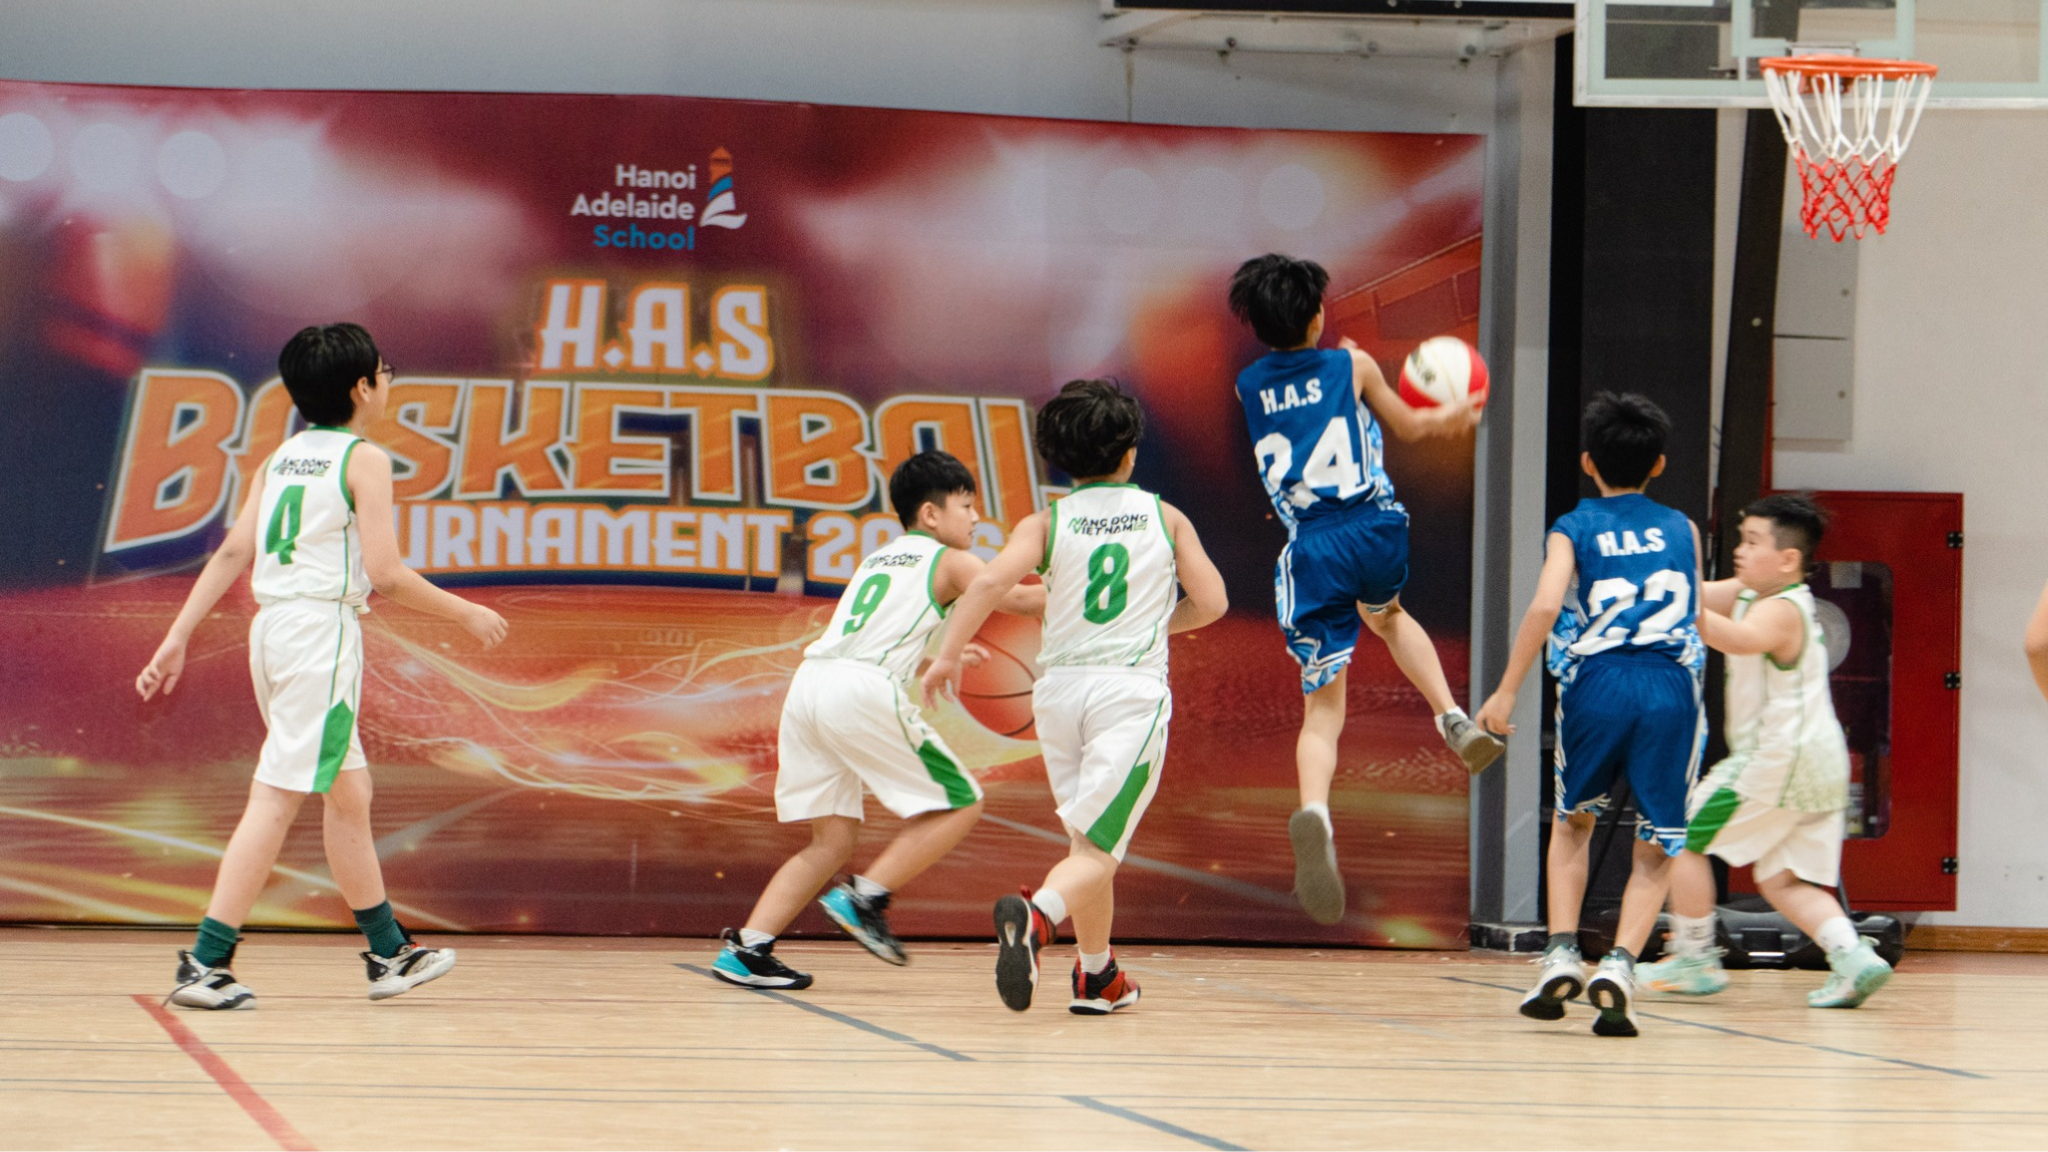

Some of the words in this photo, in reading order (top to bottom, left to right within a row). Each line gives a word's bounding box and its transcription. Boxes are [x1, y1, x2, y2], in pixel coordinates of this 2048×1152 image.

[570, 192, 695, 220] Adelaide
[615, 164, 697, 190] Hanoi
[593, 223, 695, 250] School
[535, 280, 773, 380] H.A.S
[1259, 377, 1323, 415] H.A.S
[104, 368, 1075, 552] BSKETBAL
[1254, 416, 1368, 510] 24
[265, 485, 305, 566] 4
[392, 500, 792, 577] URNAMENT
[806, 512, 1005, 581] 206
[1596, 528, 1666, 557] H.A.S
[842, 573, 891, 637] 9
[1083, 542, 1130, 625] 8
[1568, 569, 1691, 656] 22
